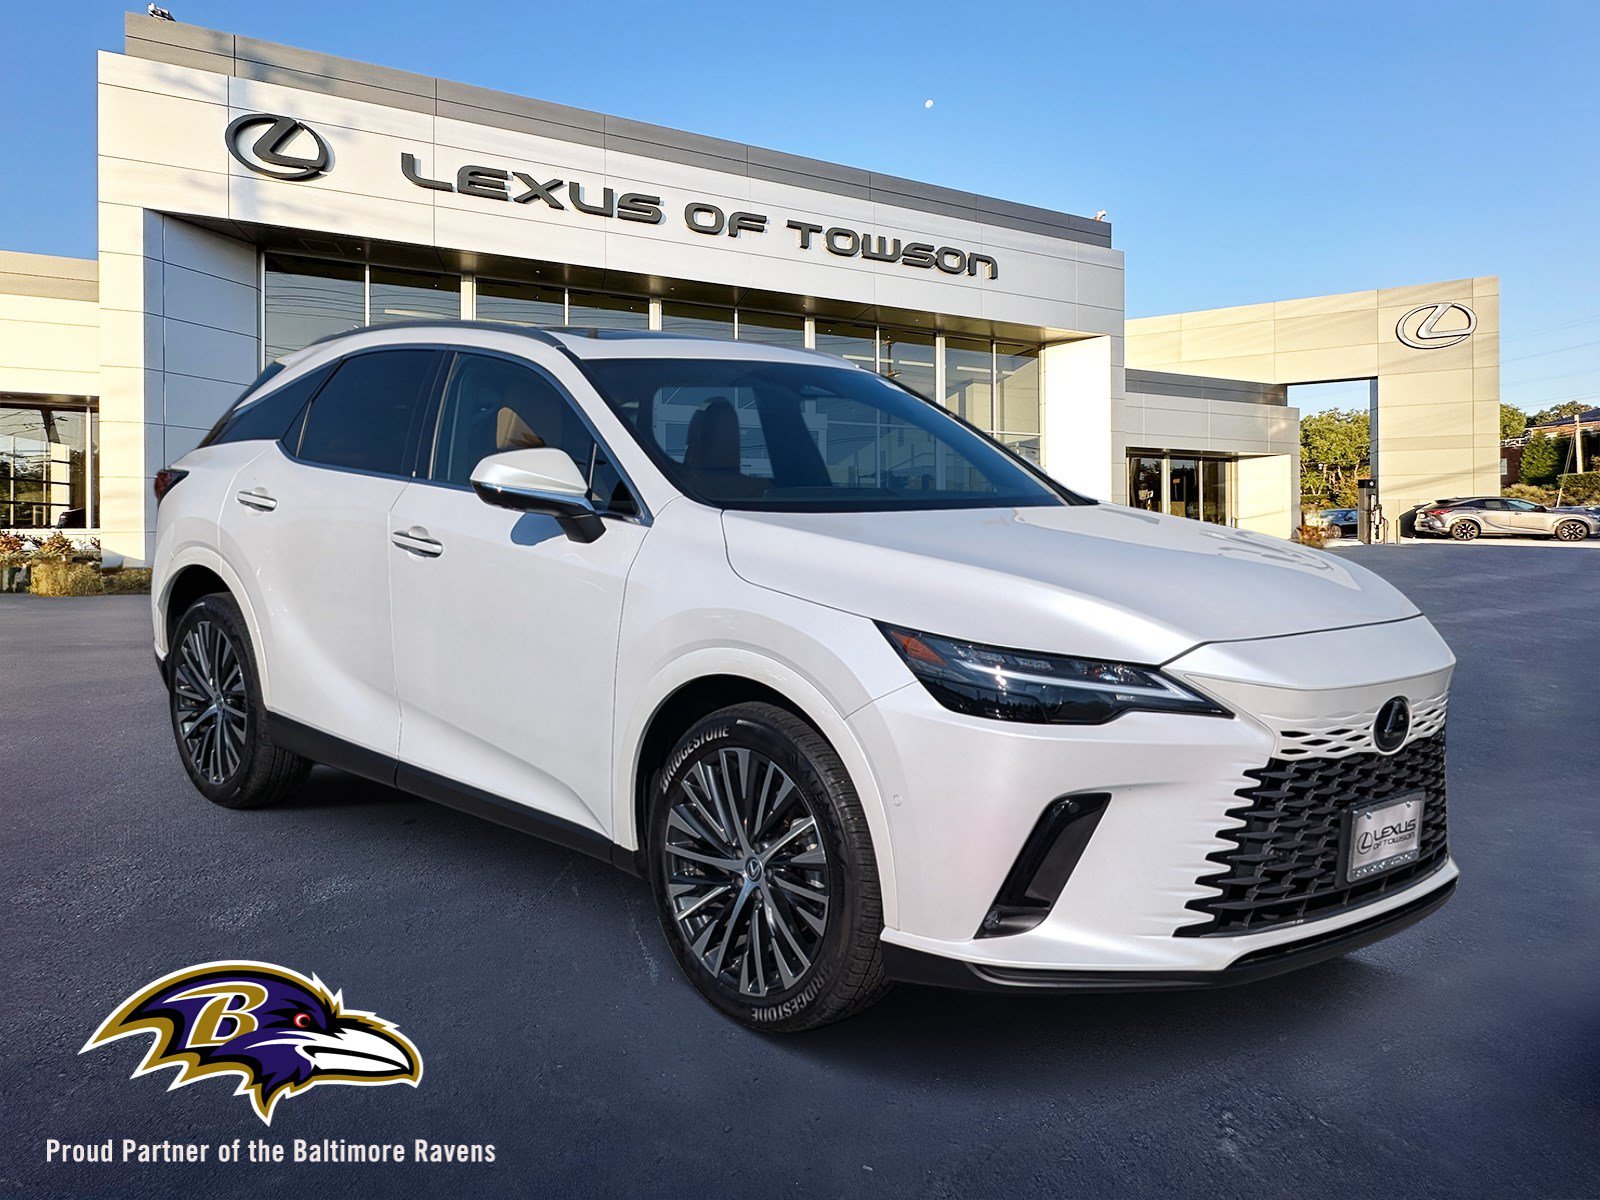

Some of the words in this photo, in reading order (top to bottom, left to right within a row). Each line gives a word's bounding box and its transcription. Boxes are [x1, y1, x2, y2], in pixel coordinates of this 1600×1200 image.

[401, 152, 663, 225] LEXUS
[684, 202, 768, 238] OF
[786, 219, 999, 280] TOWSON
[660, 725, 730, 795] BRIDGESTONE
[1373, 841, 1382, 850] OF
[1384, 832, 1415, 846] TOWSON
[1374, 819, 1416, 841] LEXUS
